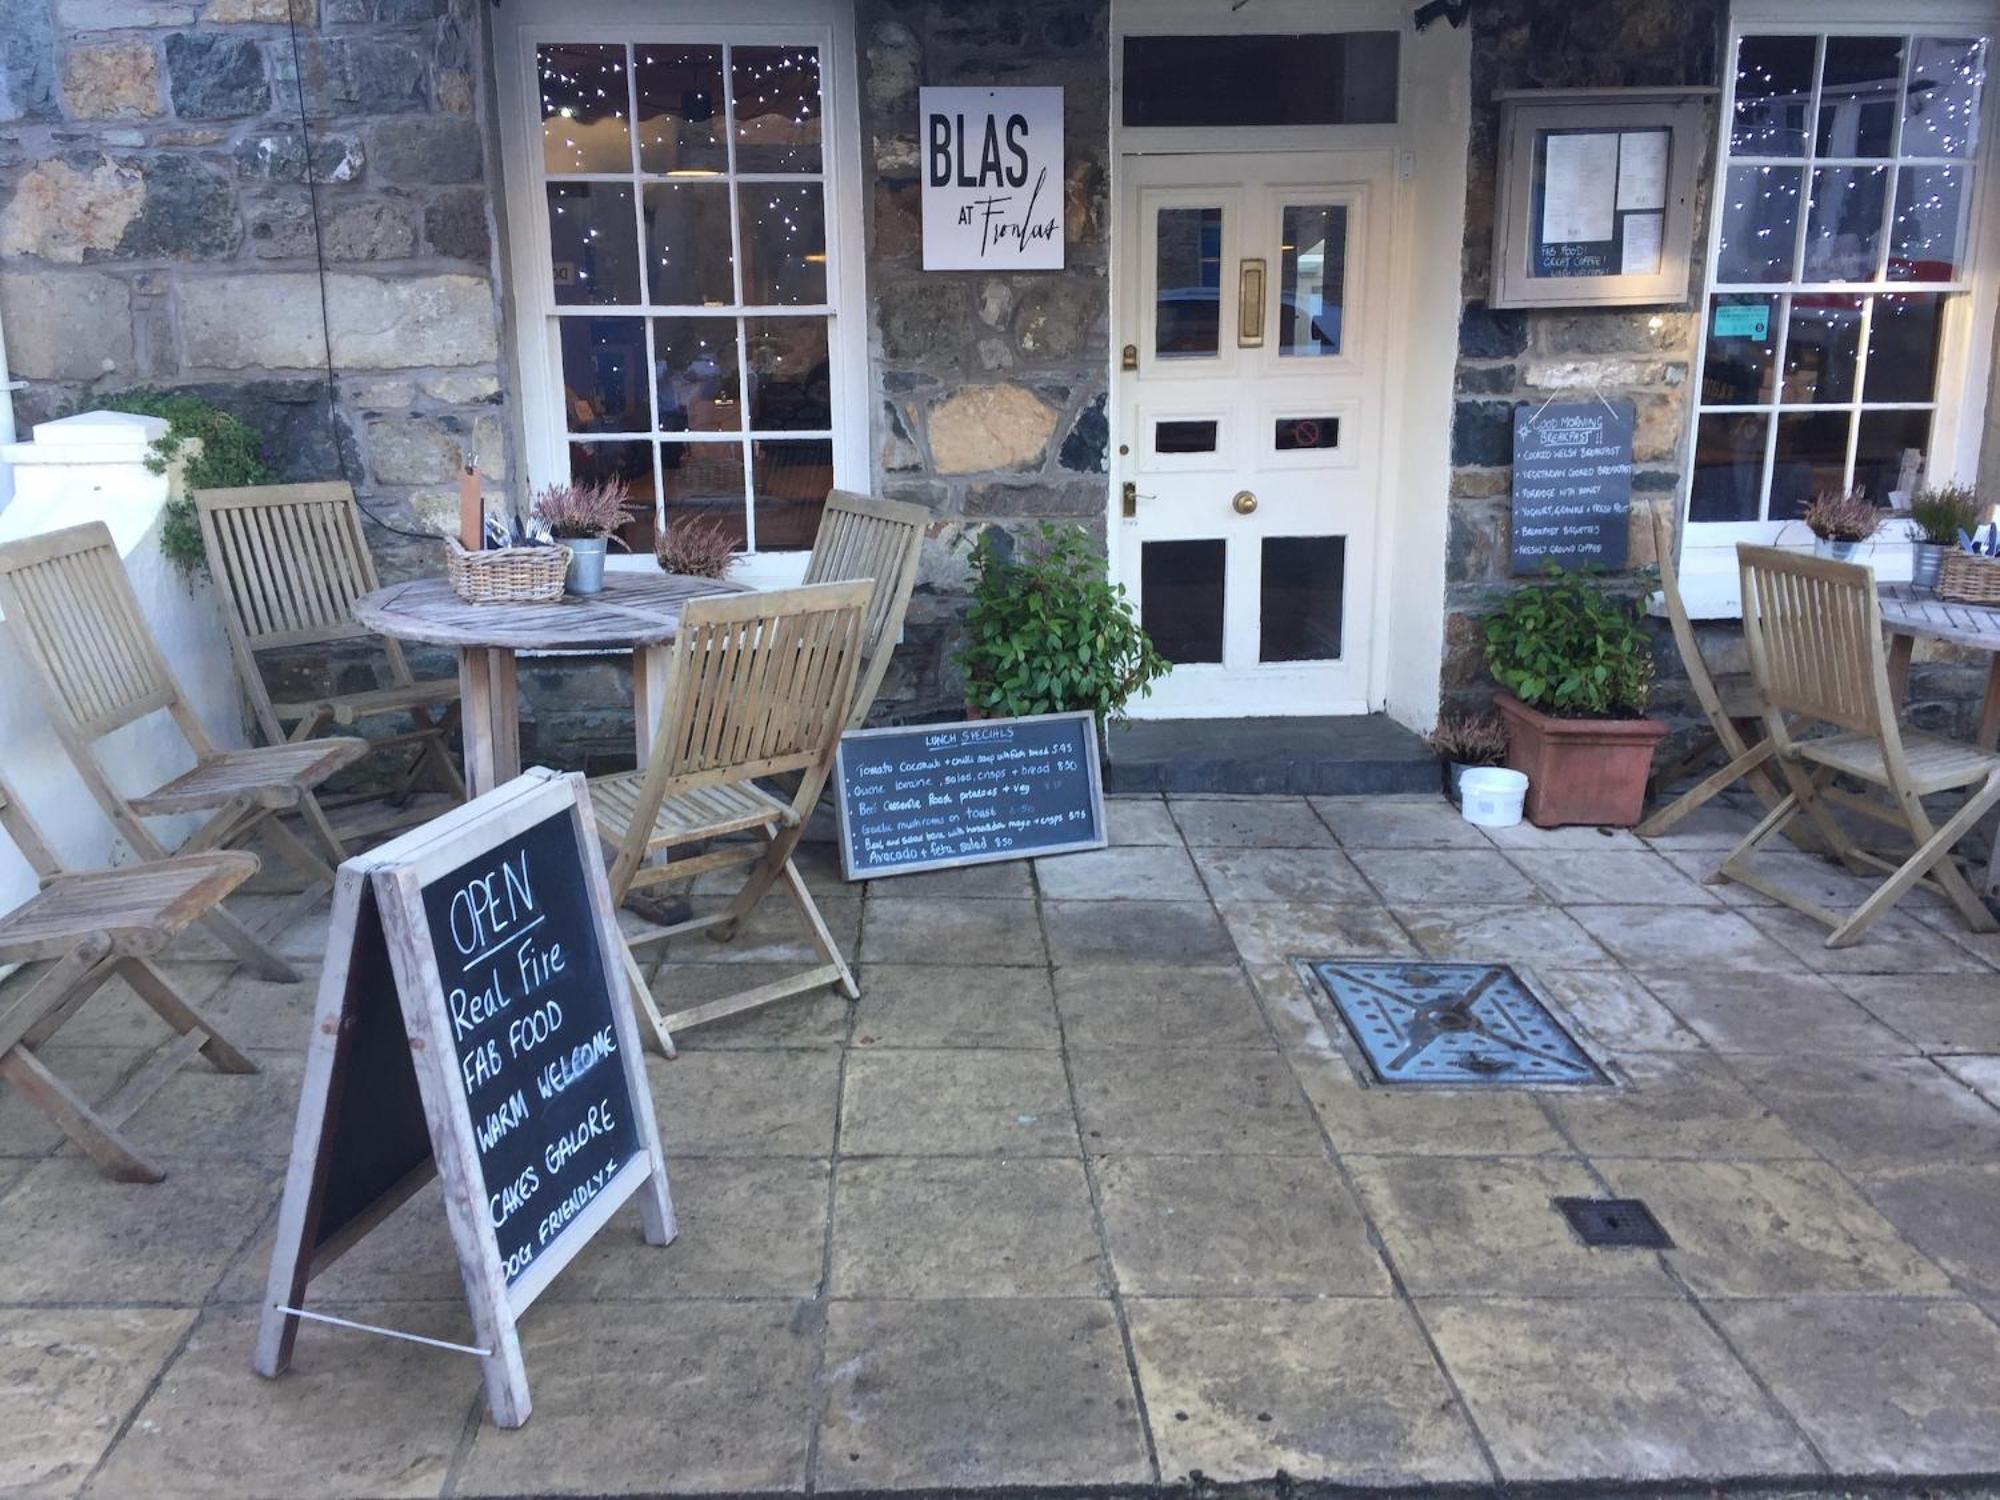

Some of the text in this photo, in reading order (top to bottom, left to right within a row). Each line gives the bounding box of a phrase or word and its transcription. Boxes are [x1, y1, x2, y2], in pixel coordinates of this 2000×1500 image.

[929, 113, 1029, 188] BLAS
[958, 205, 974, 225] AT
[1533, 415, 1602, 430] GOOD MORNING
[1540, 430, 1592, 445] BREAKFAST
[926, 726, 1014, 747] LUNCH SPECIALS
[856, 761, 892, 777] Tomato
[1021, 761, 1050, 776] bread
[948, 813, 960, 823] on
[966, 805, 997, 819] toast
[869, 847, 918, 864] Avocado
[450, 849, 534, 955] OPEN
[450, 937, 566, 1042] Real Fire
[462, 1001, 562, 1095] FAB FOOD
[476, 1024, 617, 1155] WARM WELCOME
[490, 1098, 616, 1229] CAKES GALORE
[501, 1243, 533, 1281] DOG
